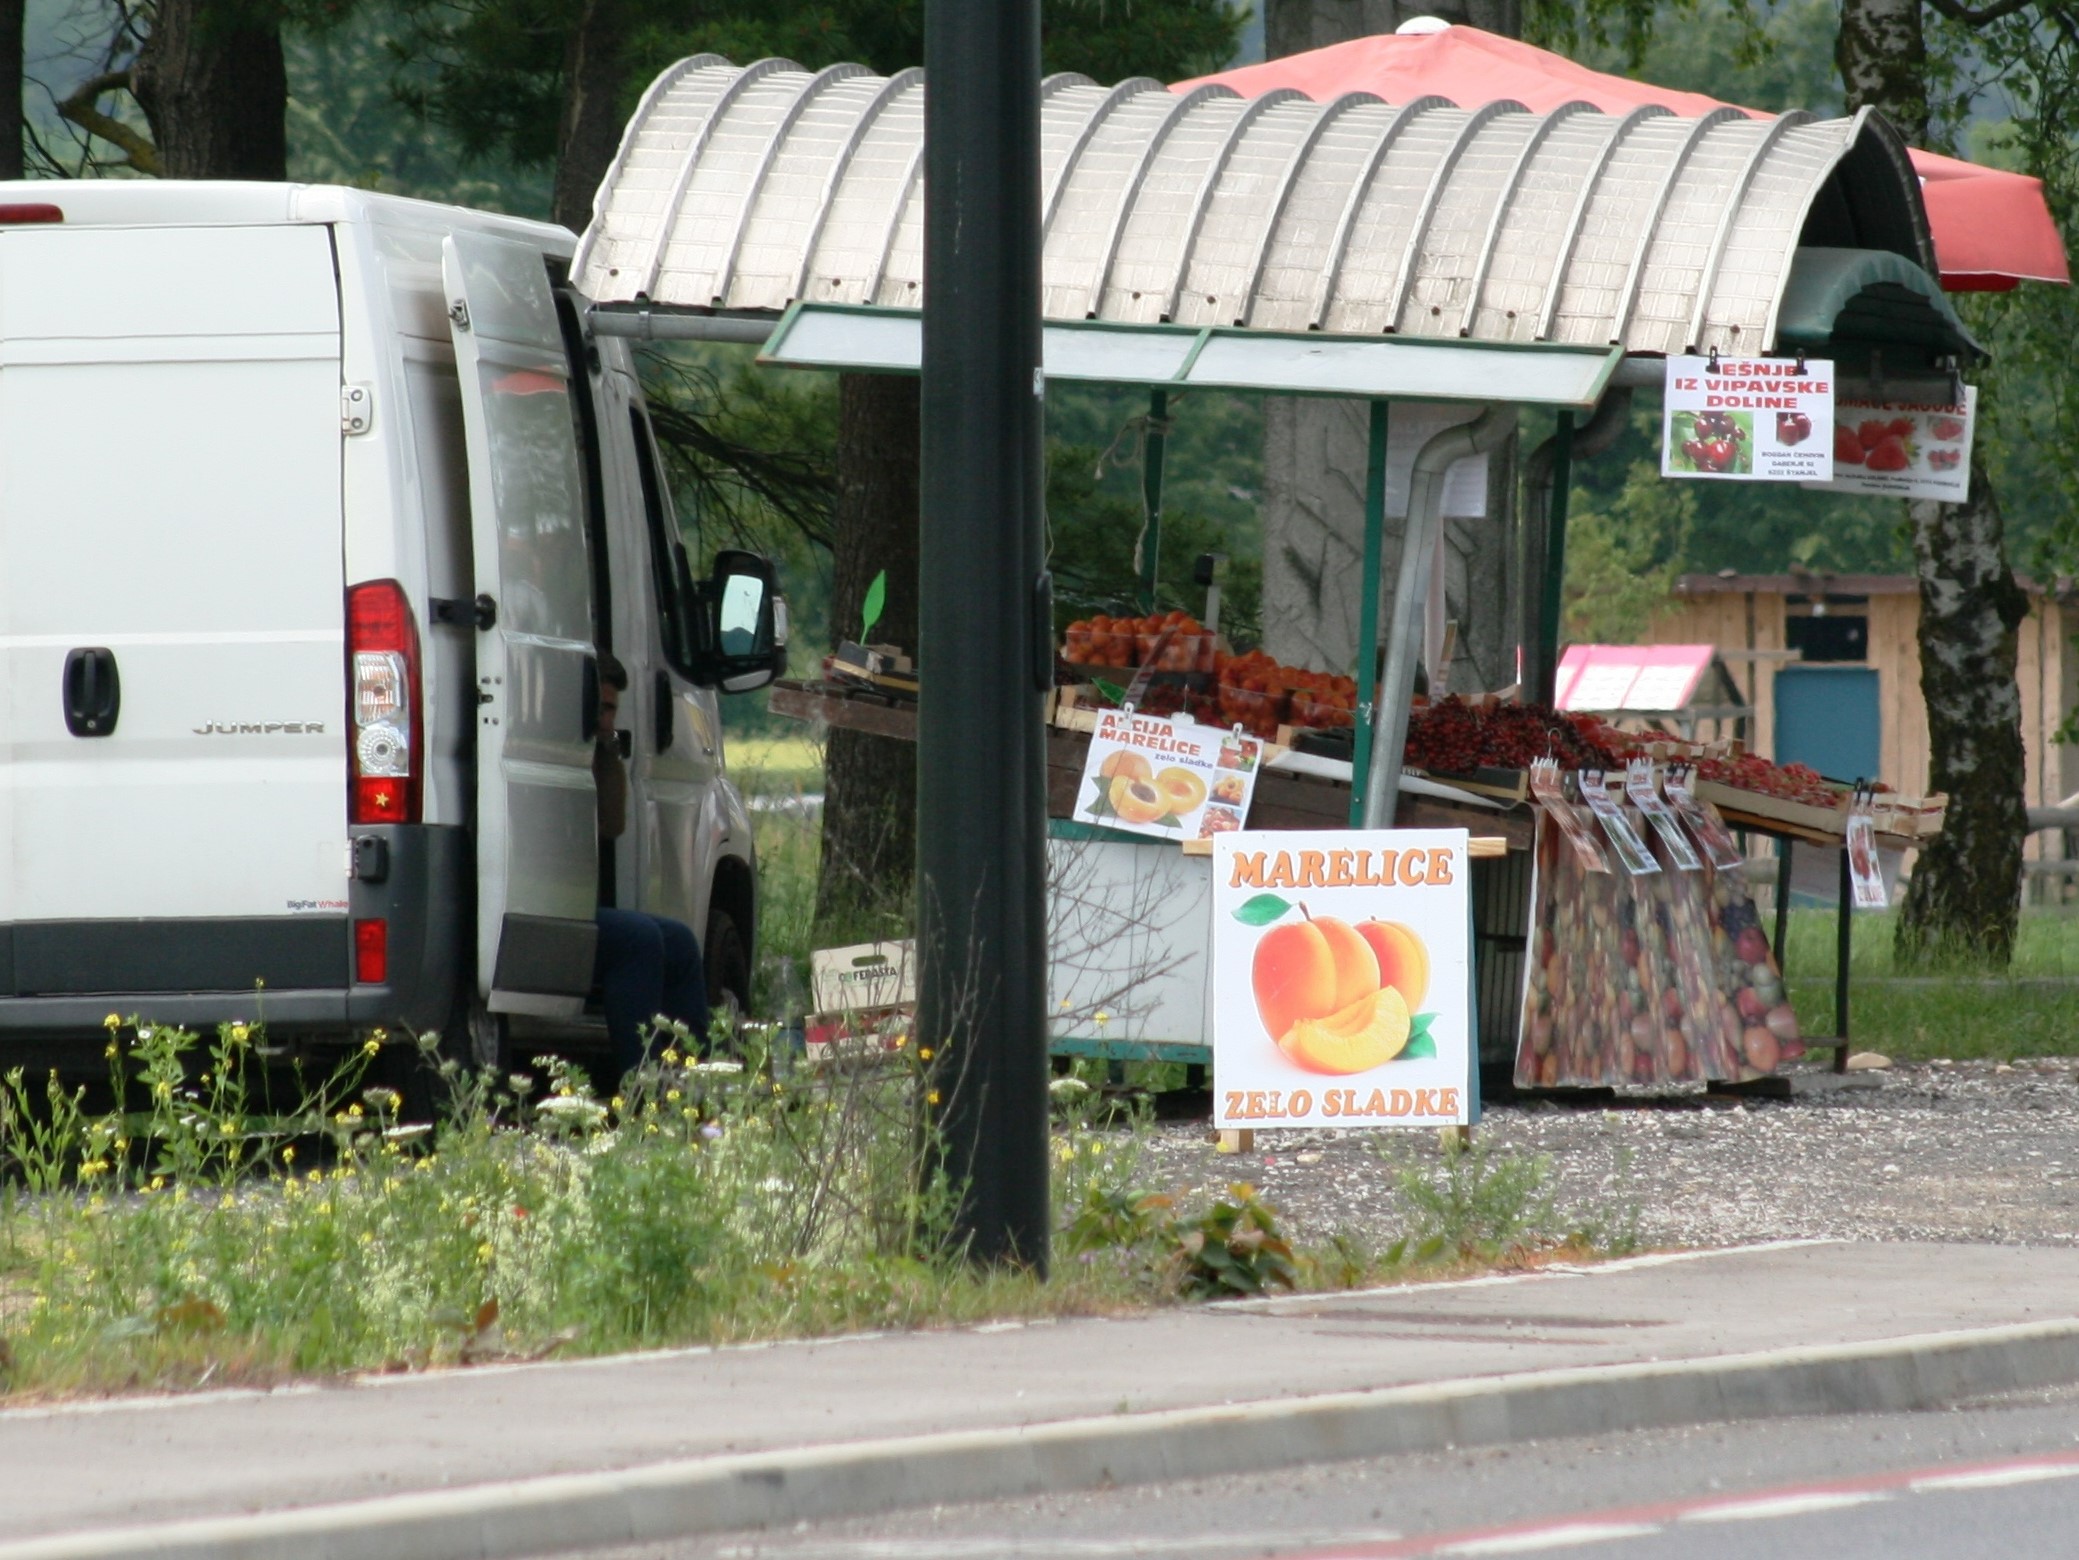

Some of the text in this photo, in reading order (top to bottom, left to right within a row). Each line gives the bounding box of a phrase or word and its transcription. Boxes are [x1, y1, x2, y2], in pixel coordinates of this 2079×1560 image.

[1708, 361, 1798, 376] EŠNJE
[1675, 378, 1829, 394] IZ VIPAVSKE
[1707, 395, 1798, 408] DOLINE
[192, 720, 324, 735] JUMPER
[1102, 714, 1173, 737] ACIJA
[1099, 728, 1201, 756] MARELICE
[1154, 753, 1214, 769] zelo sladke
[1229, 848, 1454, 888] MARELICE
[1225, 1087, 1459, 1120] ZELO SLADKE
